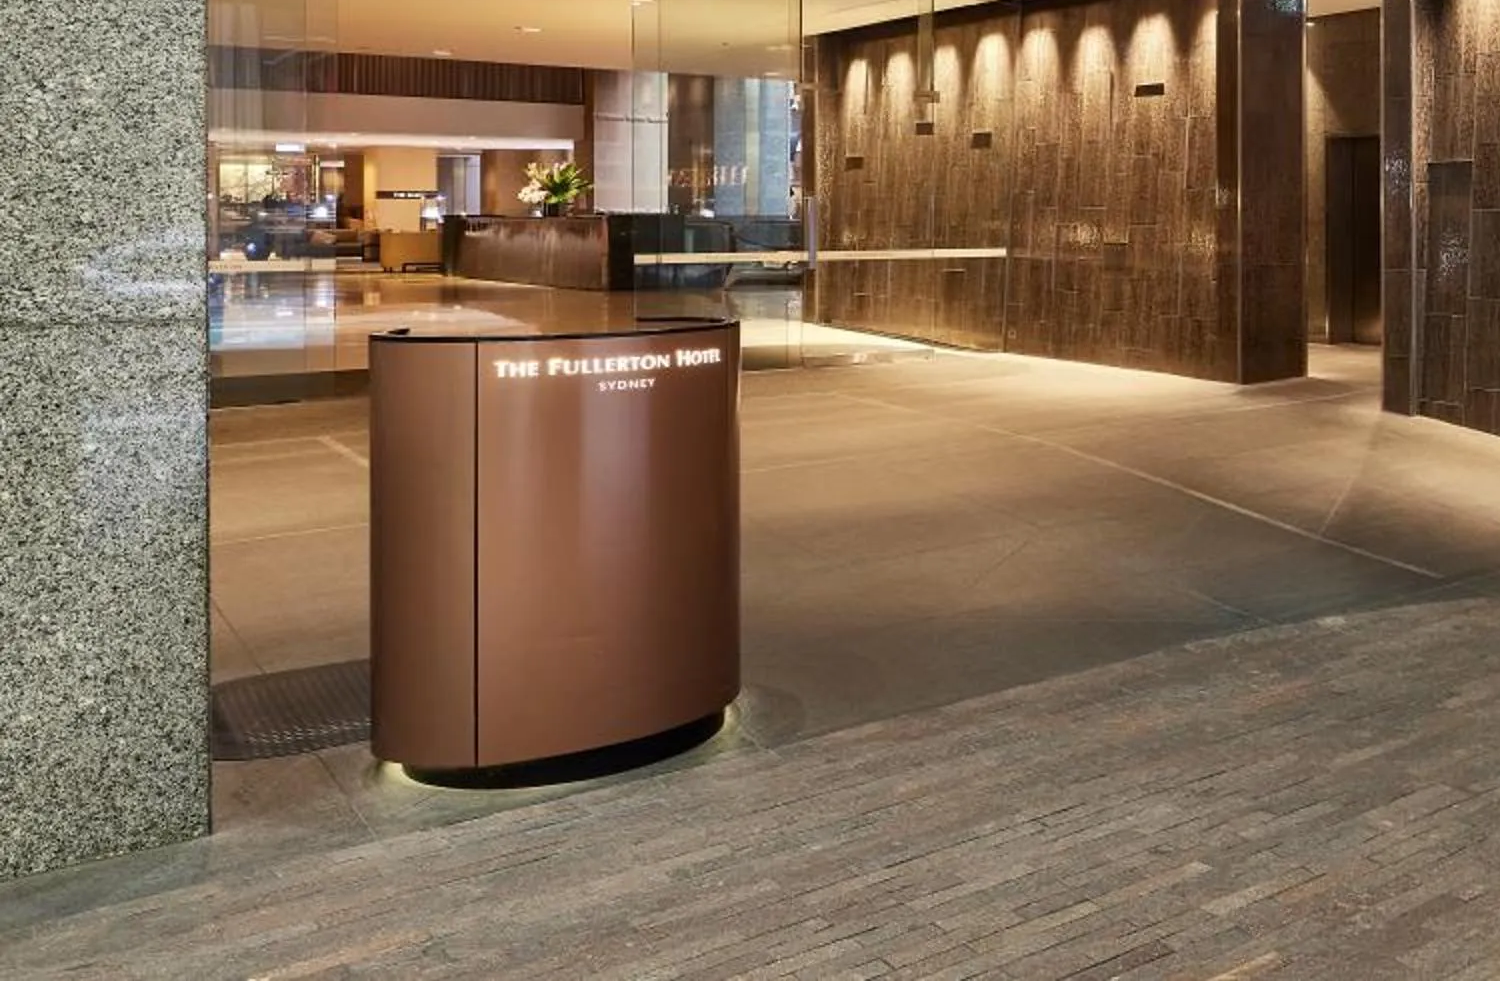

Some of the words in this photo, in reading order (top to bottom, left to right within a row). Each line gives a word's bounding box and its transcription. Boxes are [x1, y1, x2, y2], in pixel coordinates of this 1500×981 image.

[494, 360, 539, 378] THE
[548, 354, 669, 377] FULLERTON
[676, 348, 721, 367] HOTEL
[599, 378, 656, 392] SYDNEY
